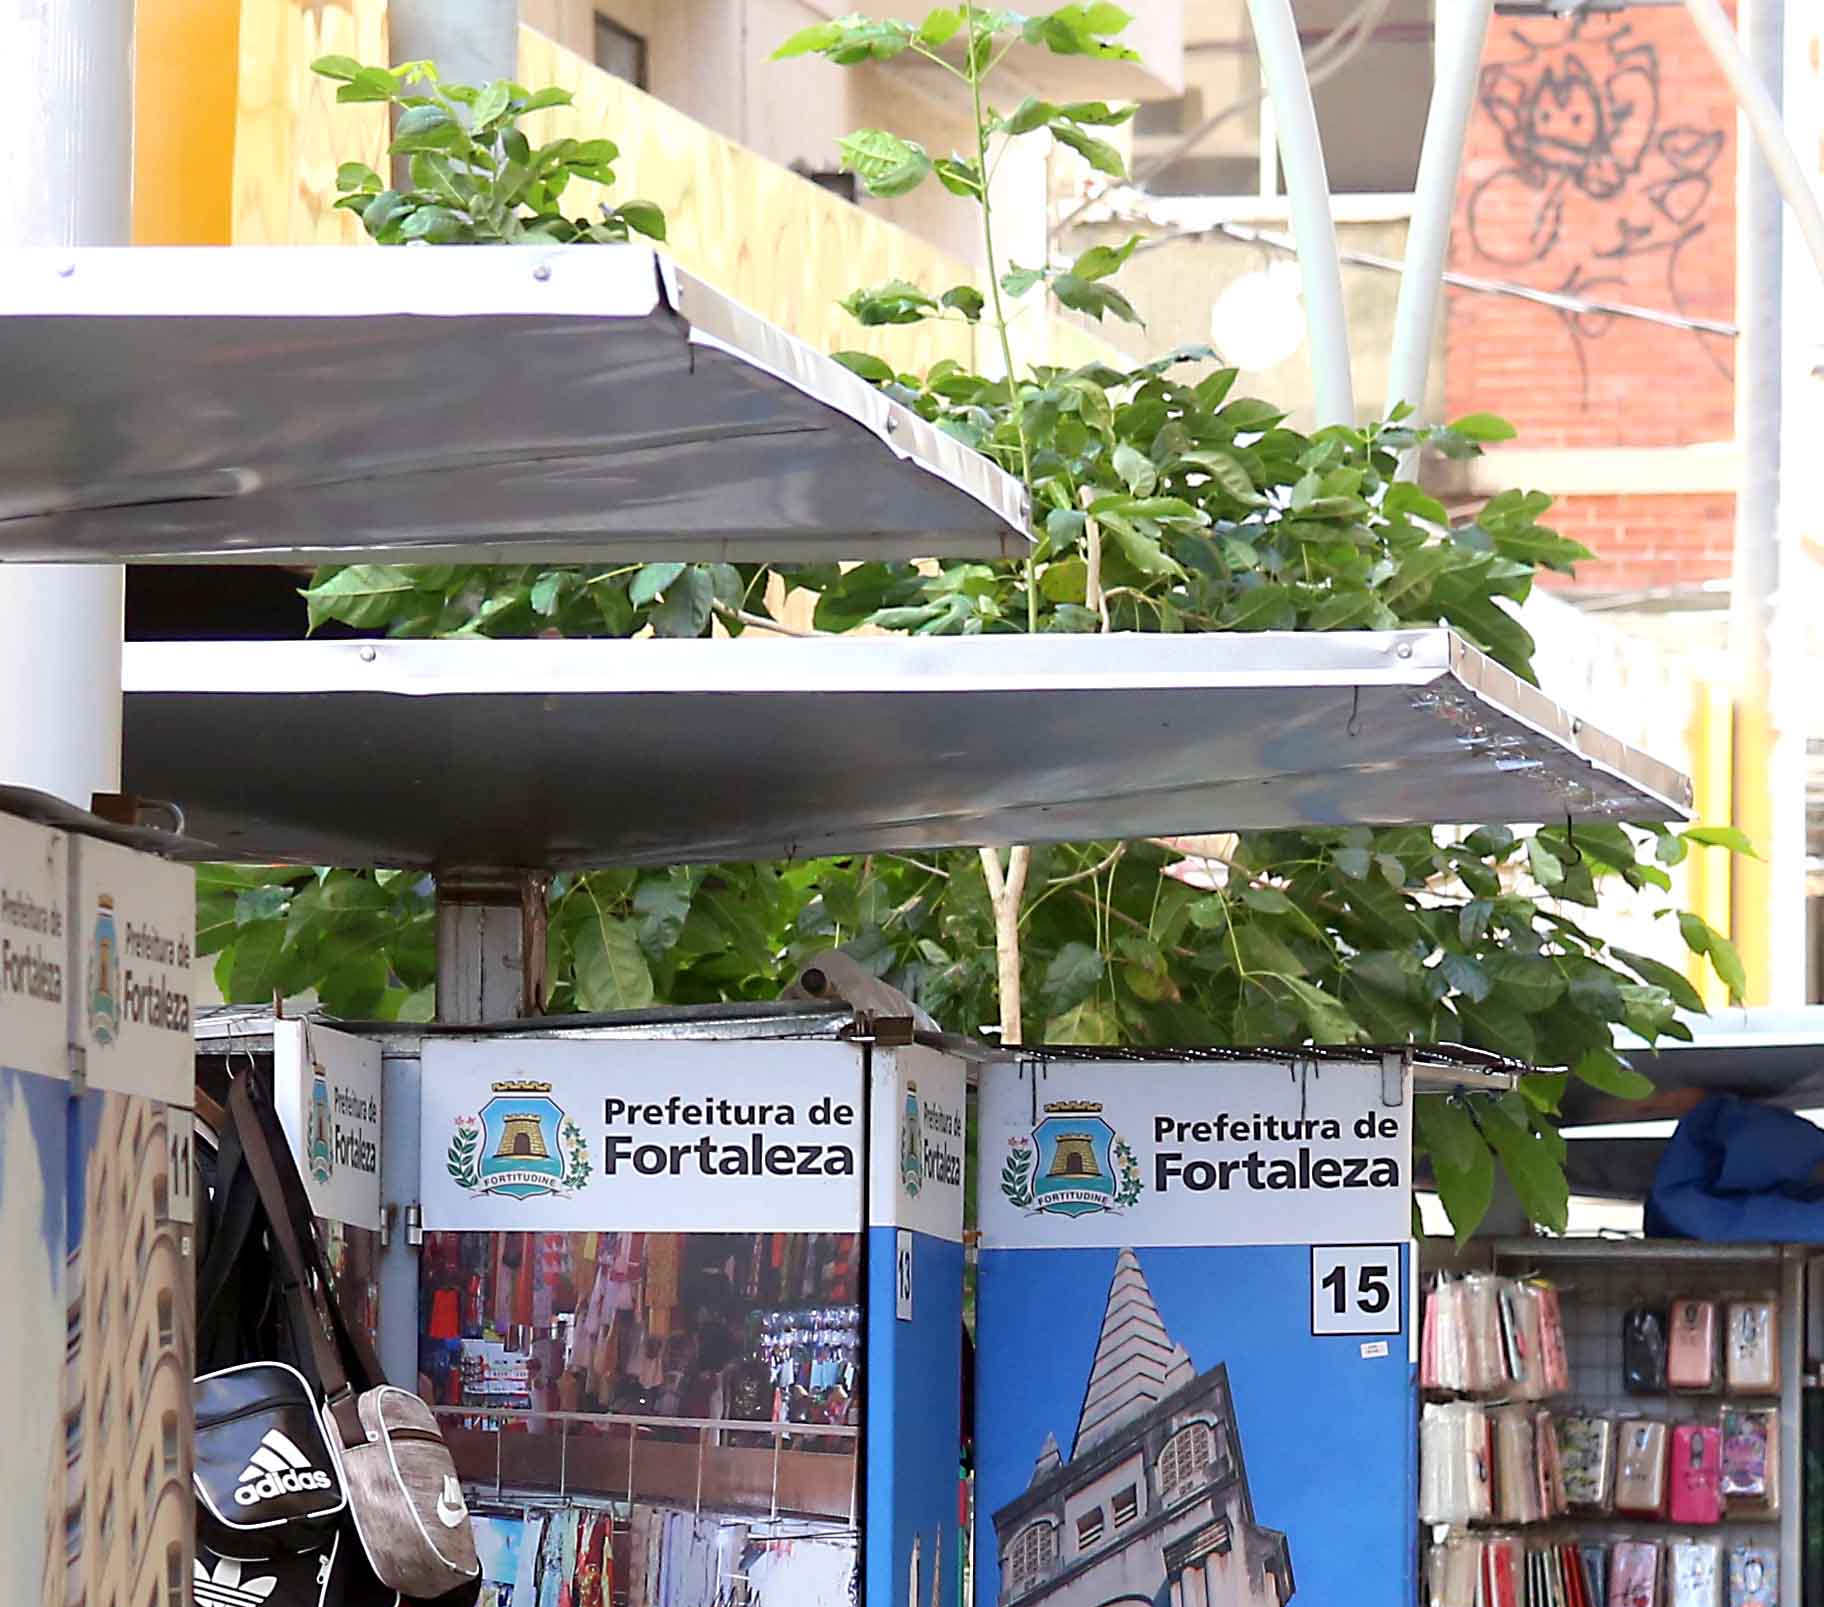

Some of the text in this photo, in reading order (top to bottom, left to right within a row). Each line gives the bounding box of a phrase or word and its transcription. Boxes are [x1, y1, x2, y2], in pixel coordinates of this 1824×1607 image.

[126, 921, 175, 967] Prefeitura
[2, 941, 64, 1003] Fortaleza
[124, 969, 191, 1034] Fortaleza
[333, 1086, 366, 1122] Prefeitura
[603, 1097, 854, 1126] Prefeitura de
[922, 1101, 952, 1137] Prefeitura
[1154, 1110, 1399, 1144] Prefeitura de
[169, 1136, 192, 1199] 11
[334, 1125, 376, 1174] Fortaleza
[603, 1134, 854, 1178] Fortaleza
[923, 1138, 961, 1188] Fortaleza
[1154, 1147, 1400, 1193] Fortaleza
[483, 1172, 557, 1188] FORTITUDINE
[1037, 1191, 1108, 1206] FORTITUDINE
[898, 1250, 911, 1301] 13
[1320, 1265, 1391, 1315] 15
[234, 1466, 332, 1506] adidas
